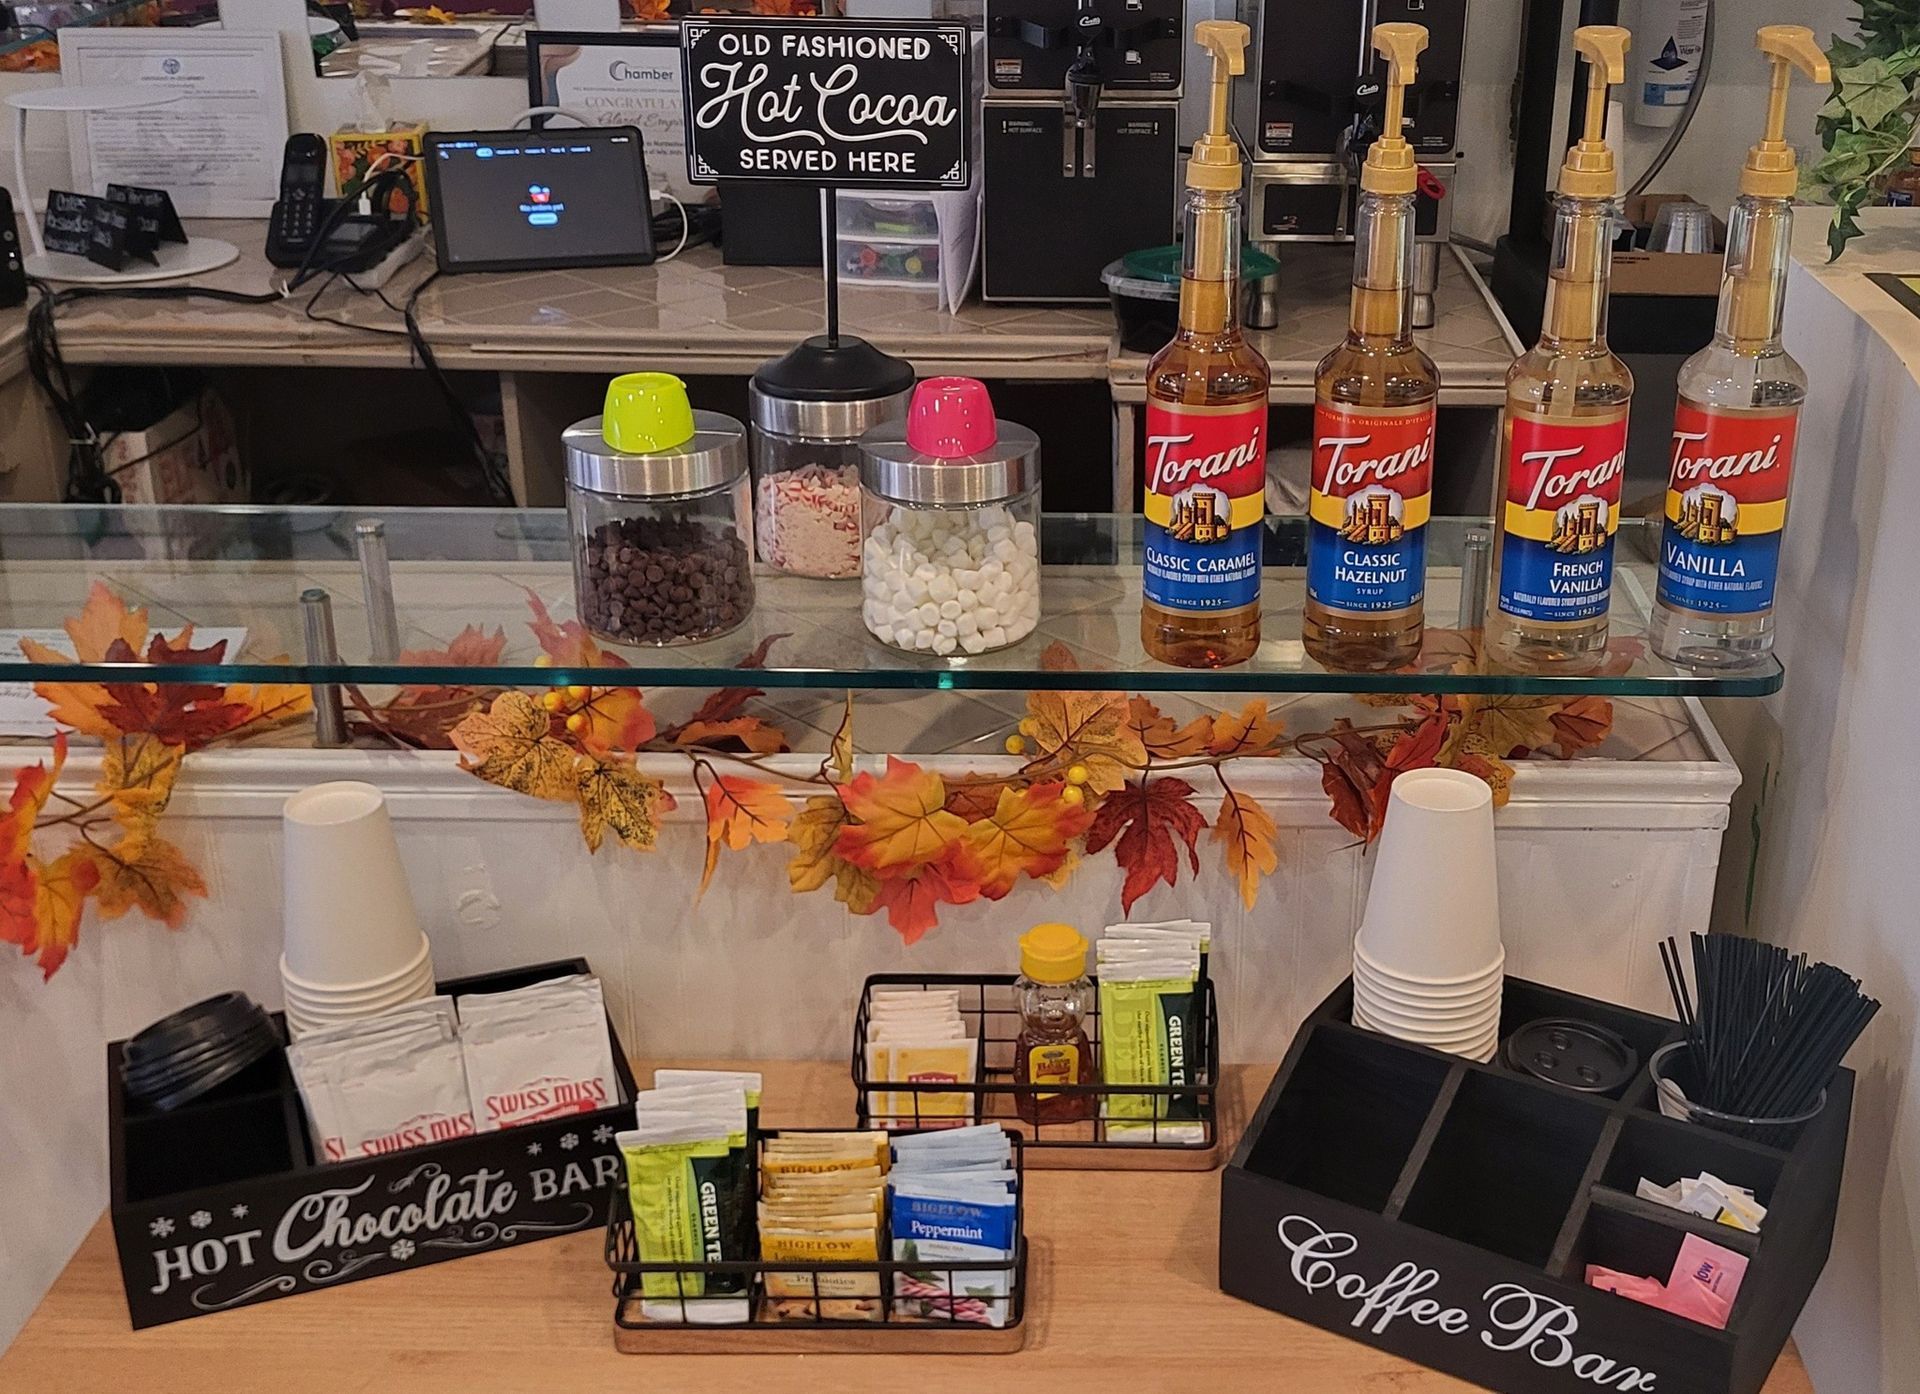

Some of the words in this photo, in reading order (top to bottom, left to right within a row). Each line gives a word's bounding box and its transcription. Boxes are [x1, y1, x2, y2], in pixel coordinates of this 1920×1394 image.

[718, 33, 771, 56] OLD
[782, 34, 931, 60] FASHIONED
[609, 60, 674, 81] Chamber
[585, 97, 682, 109] CONGRATULA
[697, 61, 826, 146] Hot
[810, 63, 957, 145] Cocoa
[739, 149, 838, 173] SERVED
[848, 151, 917, 174] HERE
[1358, 418, 1403, 426] ORIGINALE
[1148, 426, 1261, 495] Torani
[1319, 427, 1432, 496] Torani
[1669, 431, 1782, 489] Torani
[1521, 444, 1625, 511] Toran
[1146, 546, 1191, 571] CLASSIC
[1196, 552, 1256, 572] CARAMEL
[1344, 550, 1401, 567] CLASSIC
[1553, 560, 1604, 577] FRENCH
[1667, 541, 1746, 577] VANILLA
[1335, 566, 1408, 584] HAZELNUT
[1549, 577, 1603, 594] VANILLA
[1176, 598, 1197, 606] SINCE
[1200, 598, 1222, 607] 1925
[1346, 601, 1368, 609] SINCE
[1371, 601, 1392, 609] 1925
[1578, 606, 1597, 616] 1925
[1698, 600, 1720, 609] 1925
[1168, 1015, 1184, 1067] GREEN
[486, 1087, 550, 1121] SWISS
[553, 1077, 608, 1104] MISS
[360, 1125, 427, 1158] SWISS
[429, 1112, 477, 1141] MIS
[700, 1182, 720, 1240] GREEN
[911, 1201, 983, 1217] BIGELOW
[150, 1229, 262, 1295] HOT
[272, 1163, 518, 1265] Chocolate
[528, 1154, 620, 1203] BAR
[911, 1220, 983, 1240] Peppermint
[705, 1240, 723, 1265] TE
[777, 1240, 853, 1250] BIGELOW
[1277, 1214, 1470, 1335] Coffee
[1479, 1282, 1657, 1394] Bar
